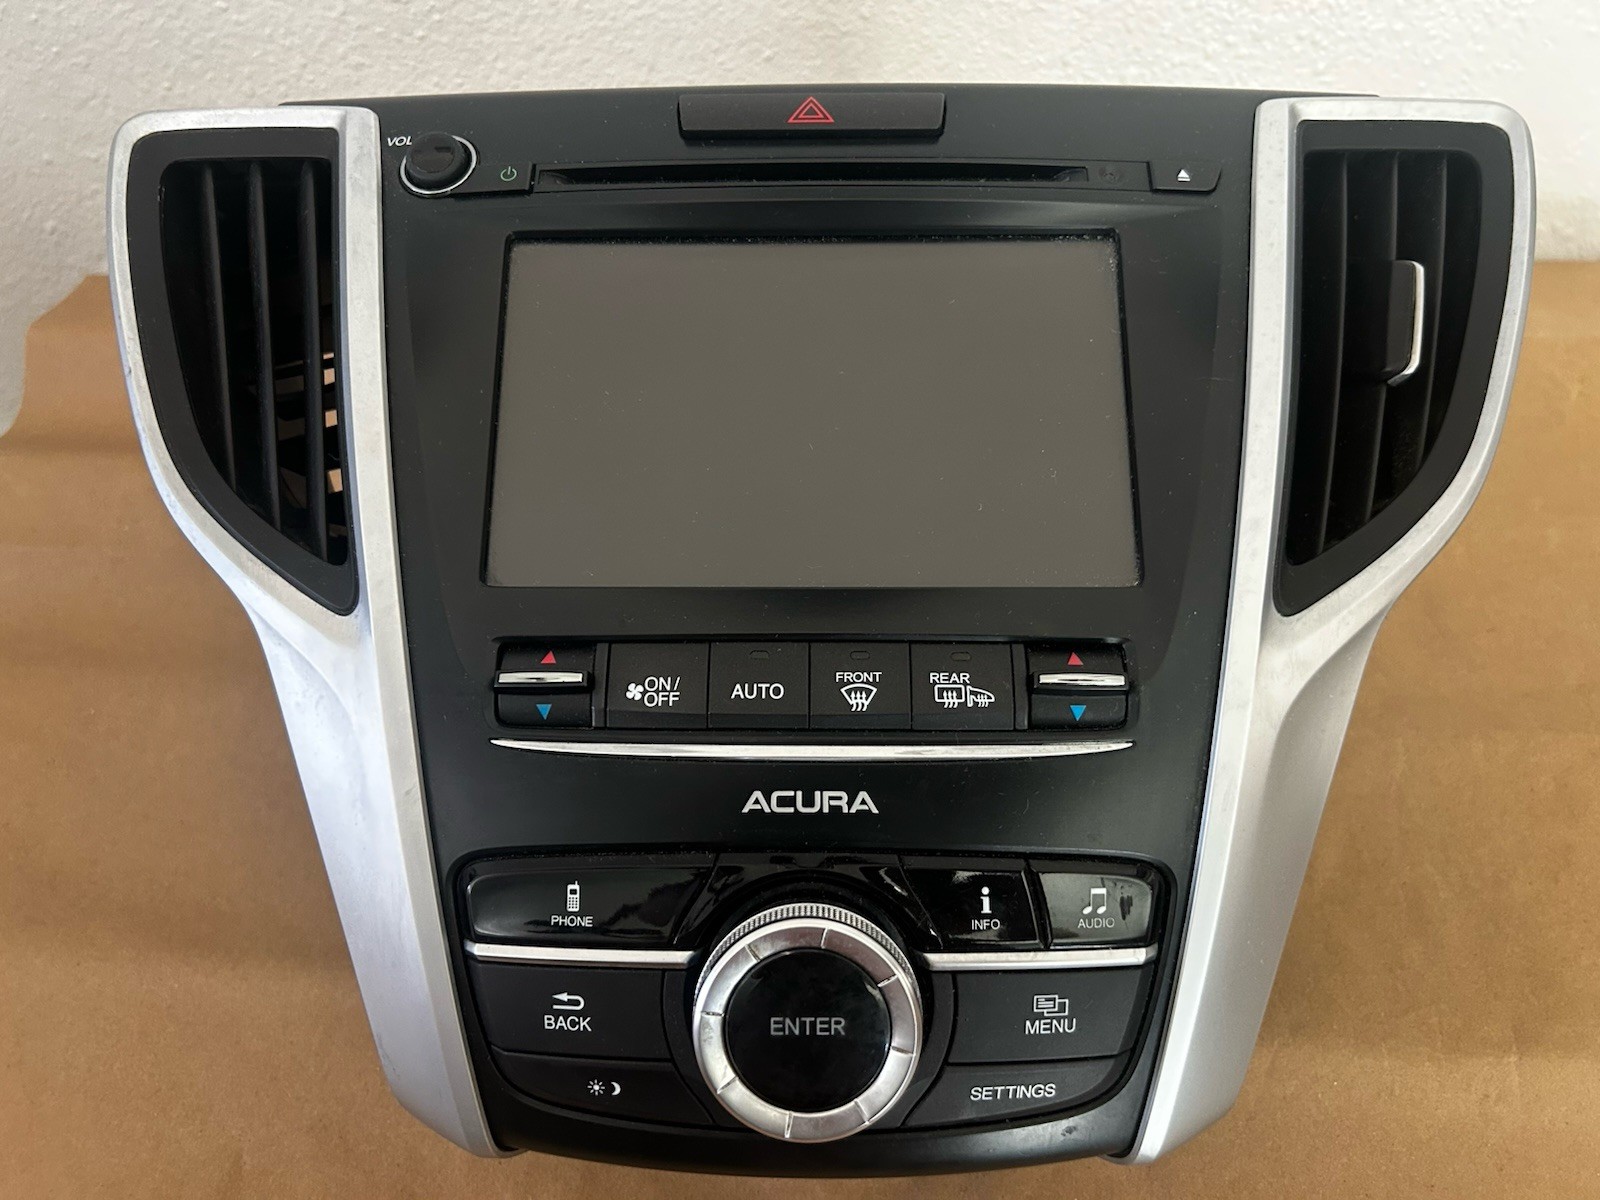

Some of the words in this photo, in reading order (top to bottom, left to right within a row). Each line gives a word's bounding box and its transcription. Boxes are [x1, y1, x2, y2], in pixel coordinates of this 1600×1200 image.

[387, 135, 412, 147] VOL
[643, 676, 681, 692] ON/
[835, 671, 882, 683] FRONT
[929, 672, 970, 684] REAR
[730, 683, 785, 700] AUTO
[643, 692, 681, 707] OFF
[741, 790, 879, 814] ACURA
[550, 915, 594, 928] PHONE
[971, 918, 1001, 931] INFO
[1077, 917, 1115, 930] AUDIO
[543, 1015, 592, 1032] BACK
[769, 1016, 846, 1036] ENTER
[1024, 1018, 1077, 1035] MENU
[970, 1083, 1056, 1101] SETTINGS
